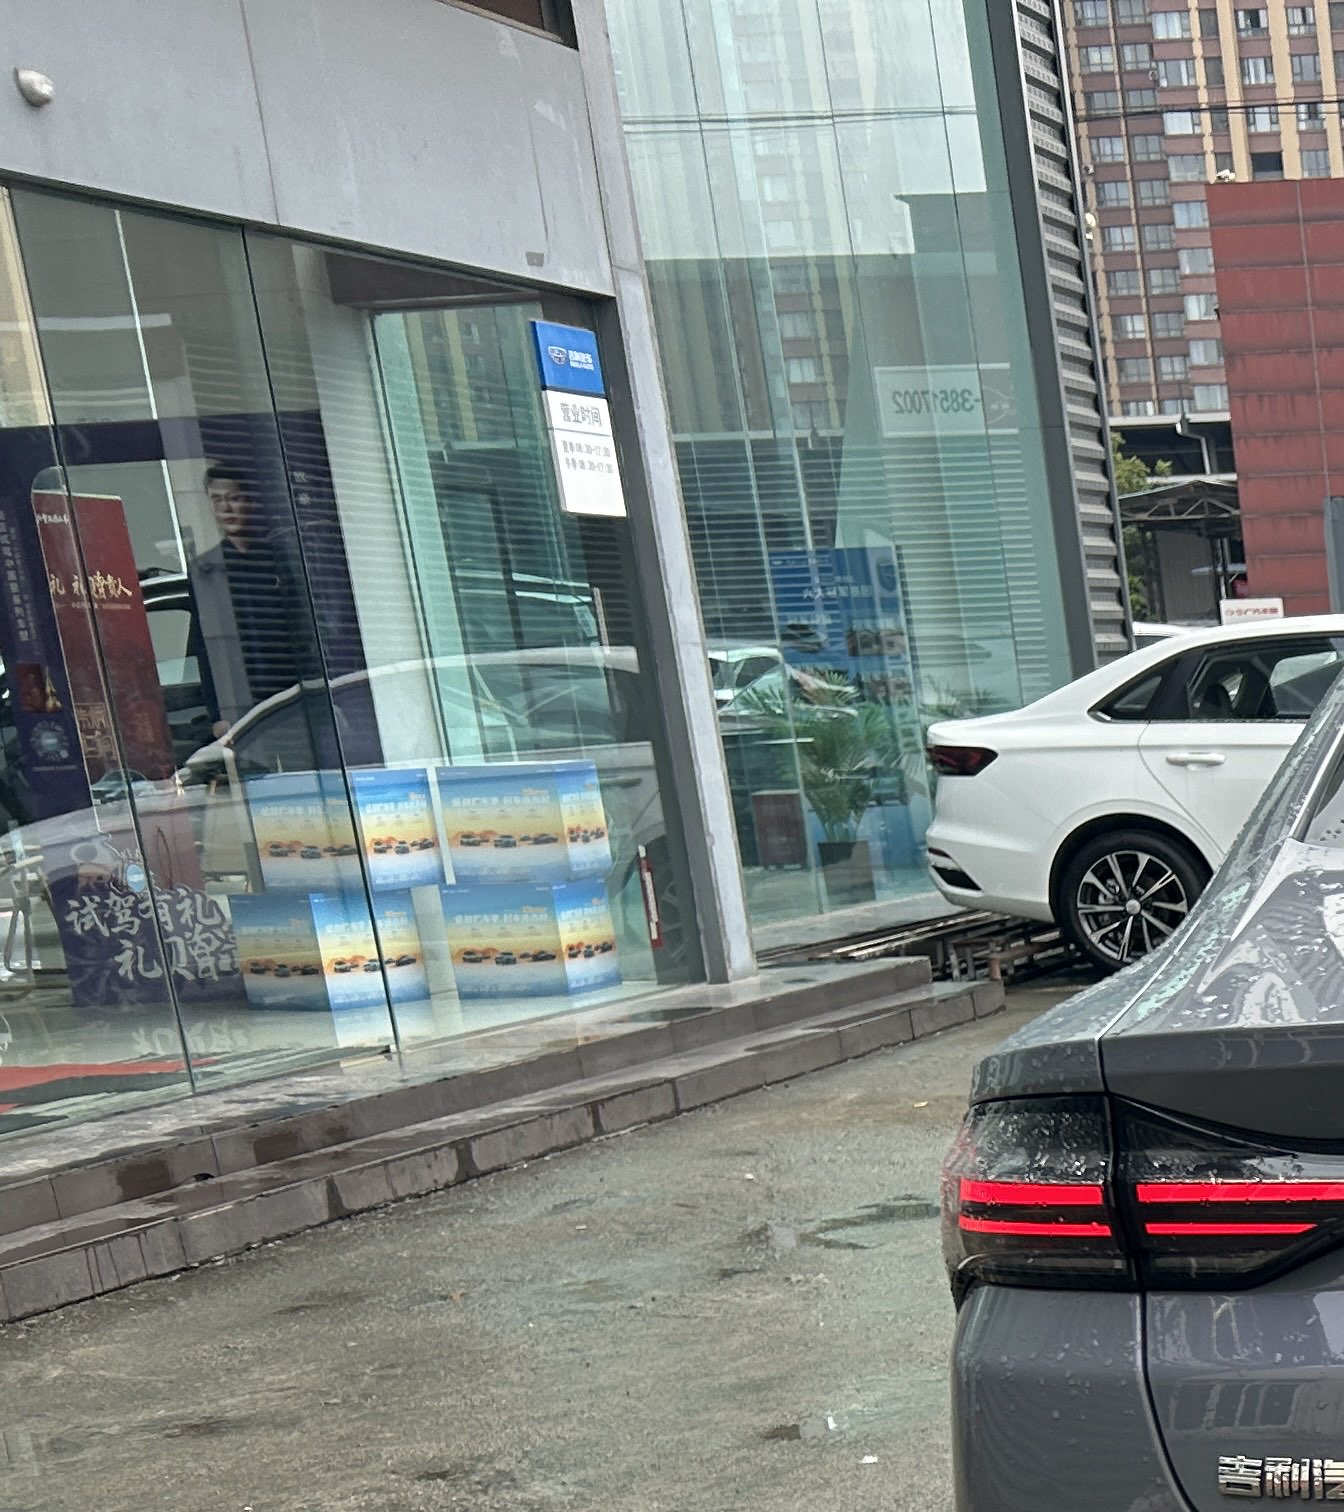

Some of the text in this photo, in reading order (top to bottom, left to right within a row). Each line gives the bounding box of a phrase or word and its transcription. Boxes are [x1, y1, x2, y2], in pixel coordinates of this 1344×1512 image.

[560, 402, 602, 426] 营业时间
[64, 888, 224, 938] 试驾有礼
